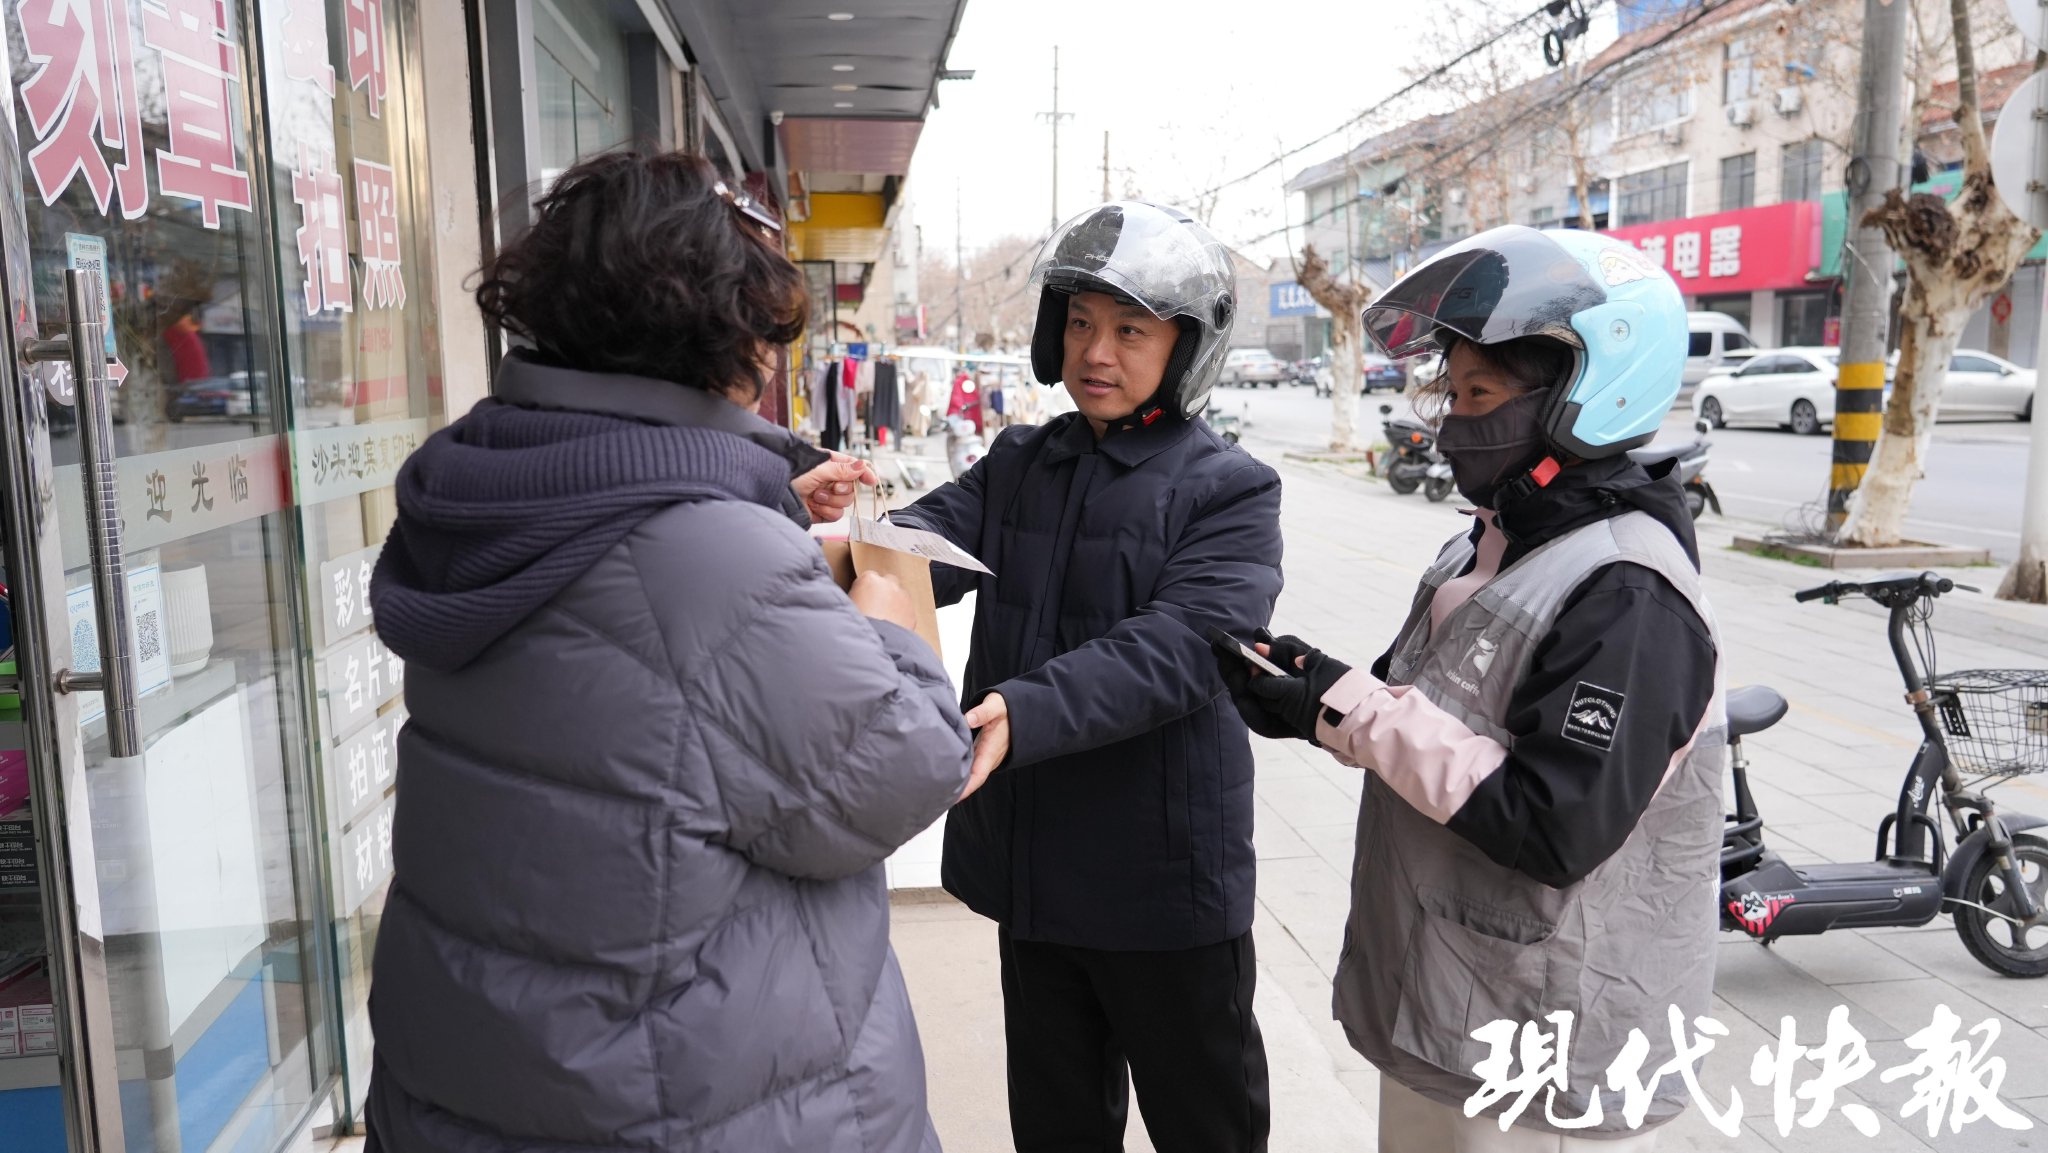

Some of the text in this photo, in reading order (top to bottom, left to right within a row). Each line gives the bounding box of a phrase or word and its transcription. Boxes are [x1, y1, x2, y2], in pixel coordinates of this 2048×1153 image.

[18, 0, 253, 230] 刻章
[291, 140, 406, 316] 拍照
[120, 452, 250, 532] 迎光临
[311, 432, 417, 487] 沙头迎宾复印社
[1573, 697, 1617, 719] OUTCLOTHING
